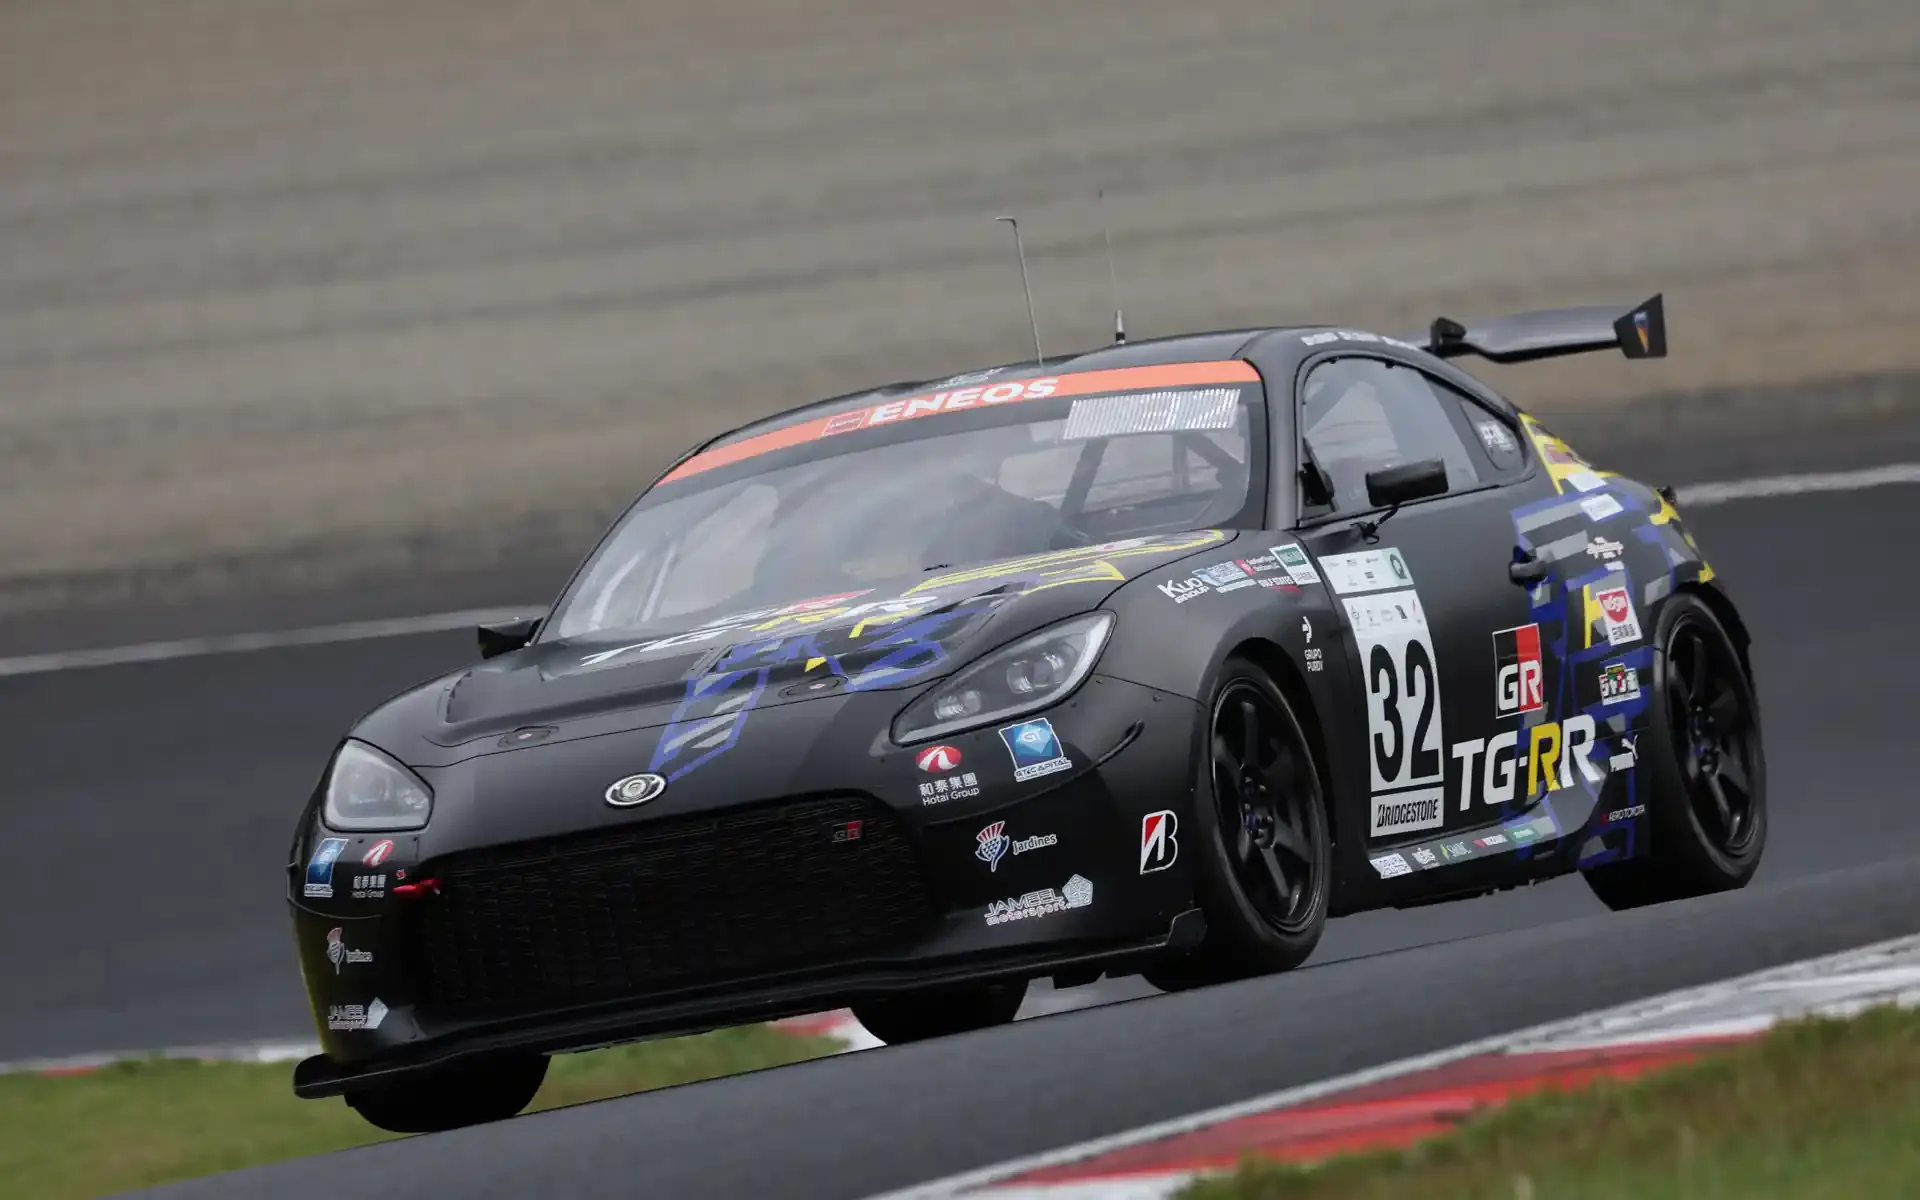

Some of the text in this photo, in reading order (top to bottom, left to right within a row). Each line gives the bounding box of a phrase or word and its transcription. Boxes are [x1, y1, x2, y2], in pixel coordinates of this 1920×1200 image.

[868, 377, 1059, 425] ENEOS
[1498, 659, 1541, 711] GR
[1370, 638, 1440, 783] 32
[1452, 714, 1602, 812] TG-RR
[919, 772, 978, 796] 和泰集團
[922, 787, 980, 806] Hotai Group
[1376, 798, 1438, 828] BRIDGESTONE
[1013, 833, 1057, 855] Jardines
[984, 888, 1064, 918] JAMEEL
